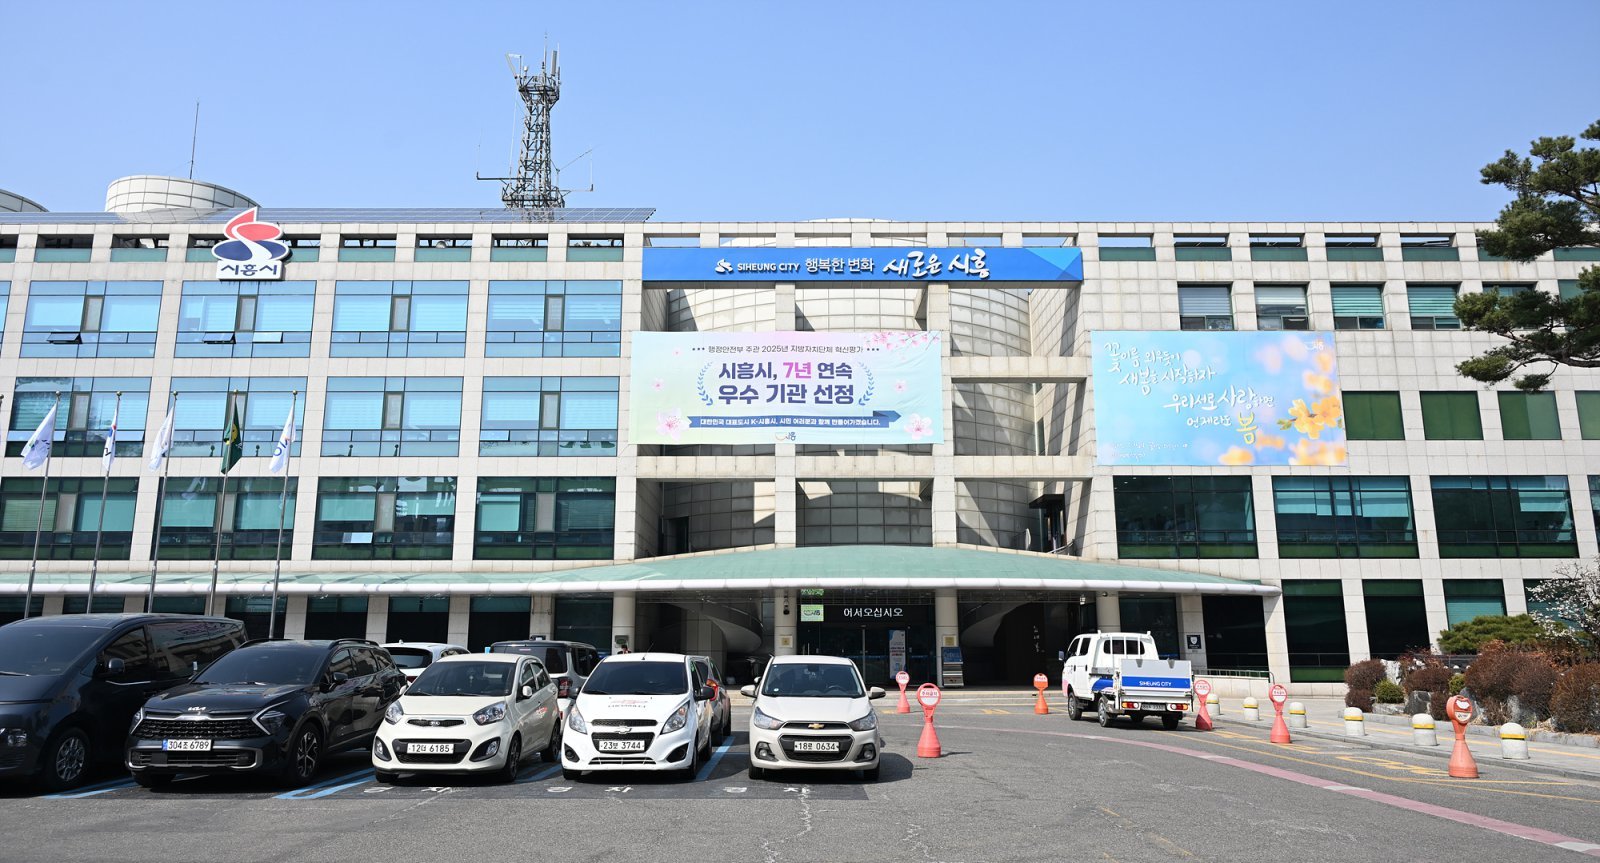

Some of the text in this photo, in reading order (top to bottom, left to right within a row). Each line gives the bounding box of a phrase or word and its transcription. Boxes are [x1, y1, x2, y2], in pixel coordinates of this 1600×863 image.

[738, 263, 800, 271] SIHEUNG CITY
[805, 248, 989, 278] 행복한 변화 새로운 시흥
[221, 264, 278, 276] 시흥시
[708, 345, 743, 353] 행정안전부
[746, 345, 760, 353] 주관
[762, 345, 789, 353] 2025년
[790, 345, 833, 353] 지방자치단체
[718, 362, 852, 380] 시흥시, 7년 연속
[1161, 363, 1216, 384] 시작하자
[718, 384, 854, 404] 우수 기관 선정
[1236, 411, 1258, 445] 봄
[843, 608, 903, 617] 어서오십시오
[168, 741, 209, 750] 304조 6789
[429, 744, 450, 753] 6185
[621, 741, 641, 750] 3744
[816, 742, 836, 750] 0634
